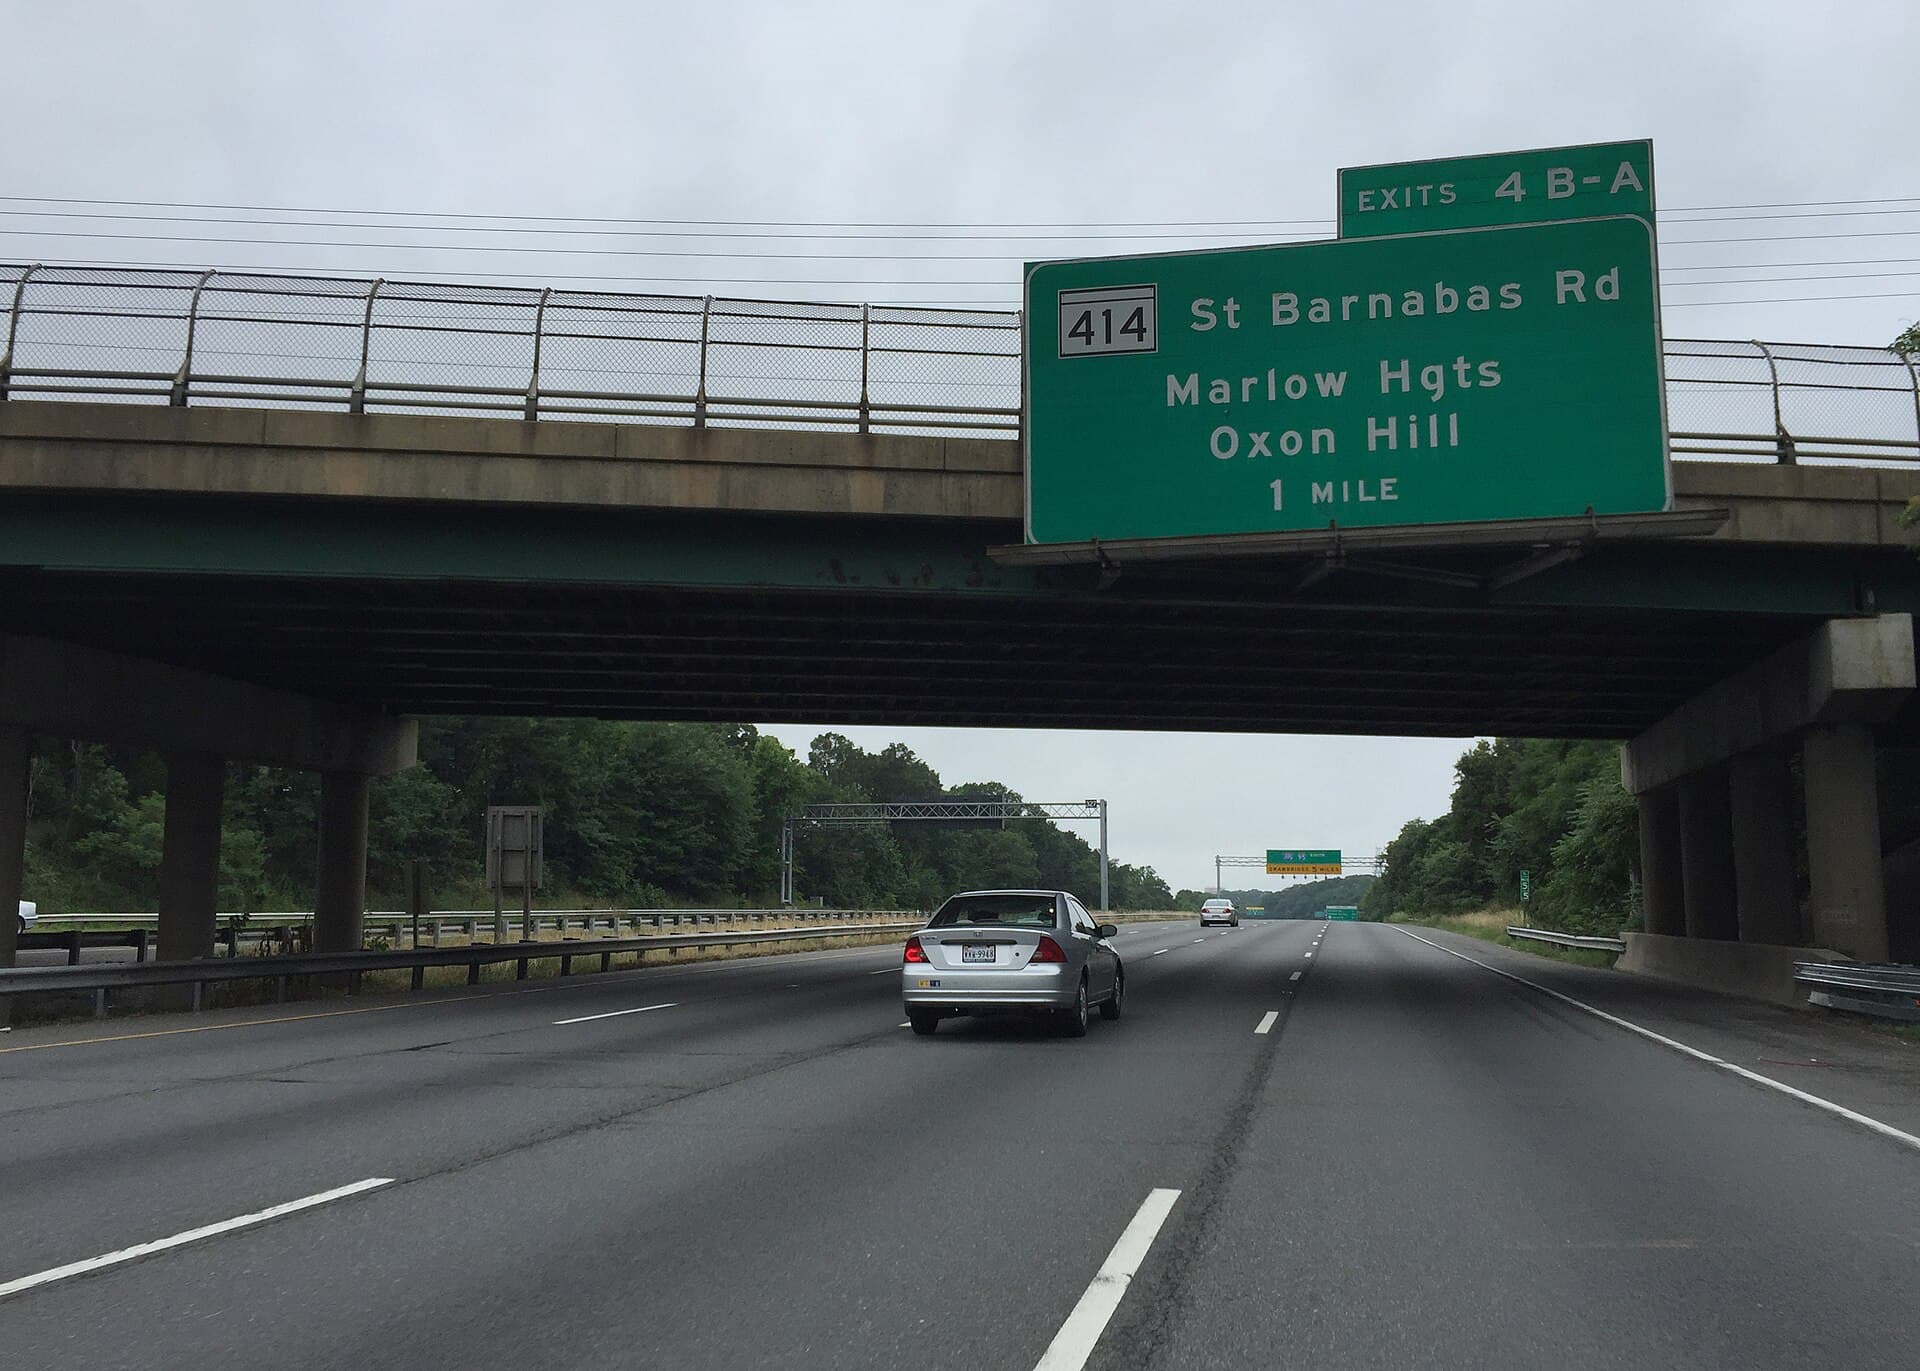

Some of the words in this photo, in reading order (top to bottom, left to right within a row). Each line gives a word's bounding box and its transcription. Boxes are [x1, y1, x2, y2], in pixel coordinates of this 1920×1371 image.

[1358, 183, 1457, 212] EXITS
[1494, 171, 1526, 202] 4
[1546, 161, 1644, 200] B-A
[1190, 297, 1241, 331] St
[1272, 281, 1522, 326] Barnabas
[1555, 266, 1620, 305] Rd
[1067, 306, 1147, 346] 414
[1166, 368, 1347, 407] Marlow
[1380, 355, 1501, 402] Hgts
[1210, 425, 1336, 460] Oxon
[1367, 412, 1458, 452] Hill
[1269, 479, 1283, 511] 1
[1311, 478, 1398, 504] MILE
